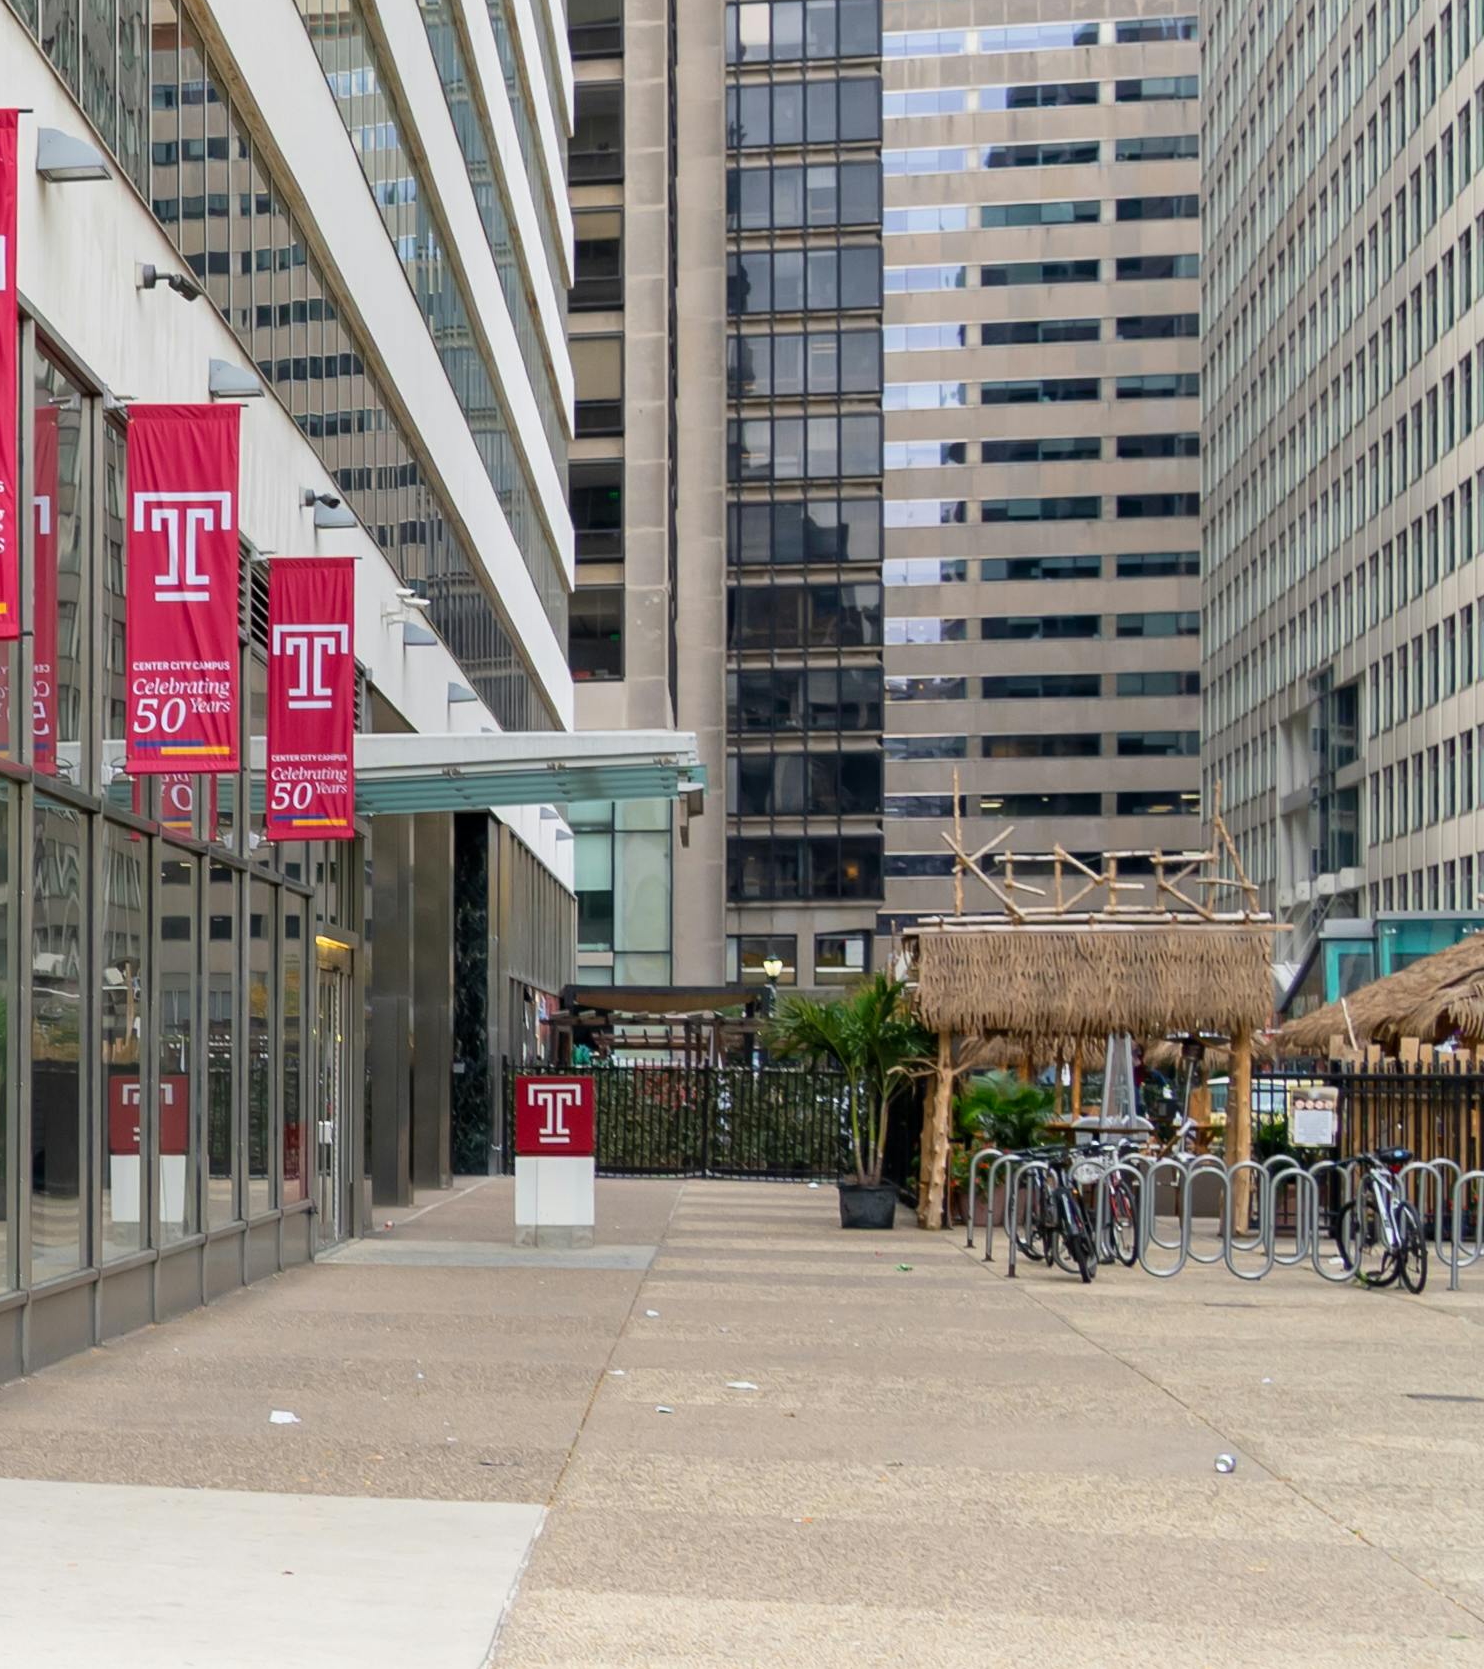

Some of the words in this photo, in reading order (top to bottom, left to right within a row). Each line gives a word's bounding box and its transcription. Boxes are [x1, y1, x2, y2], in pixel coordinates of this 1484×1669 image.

[132, 661, 169, 671] CENTER
[170, 661, 193, 670] CITY
[192, 661, 230, 671] CAMPUS
[132, 677, 230, 699] Celebrating
[133, 697, 187, 734] 50
[190, 697, 231, 713] Years
[271, 766, 348, 783] Celebrating
[271, 782, 313, 810] 50
[315, 782, 348, 795] Years
